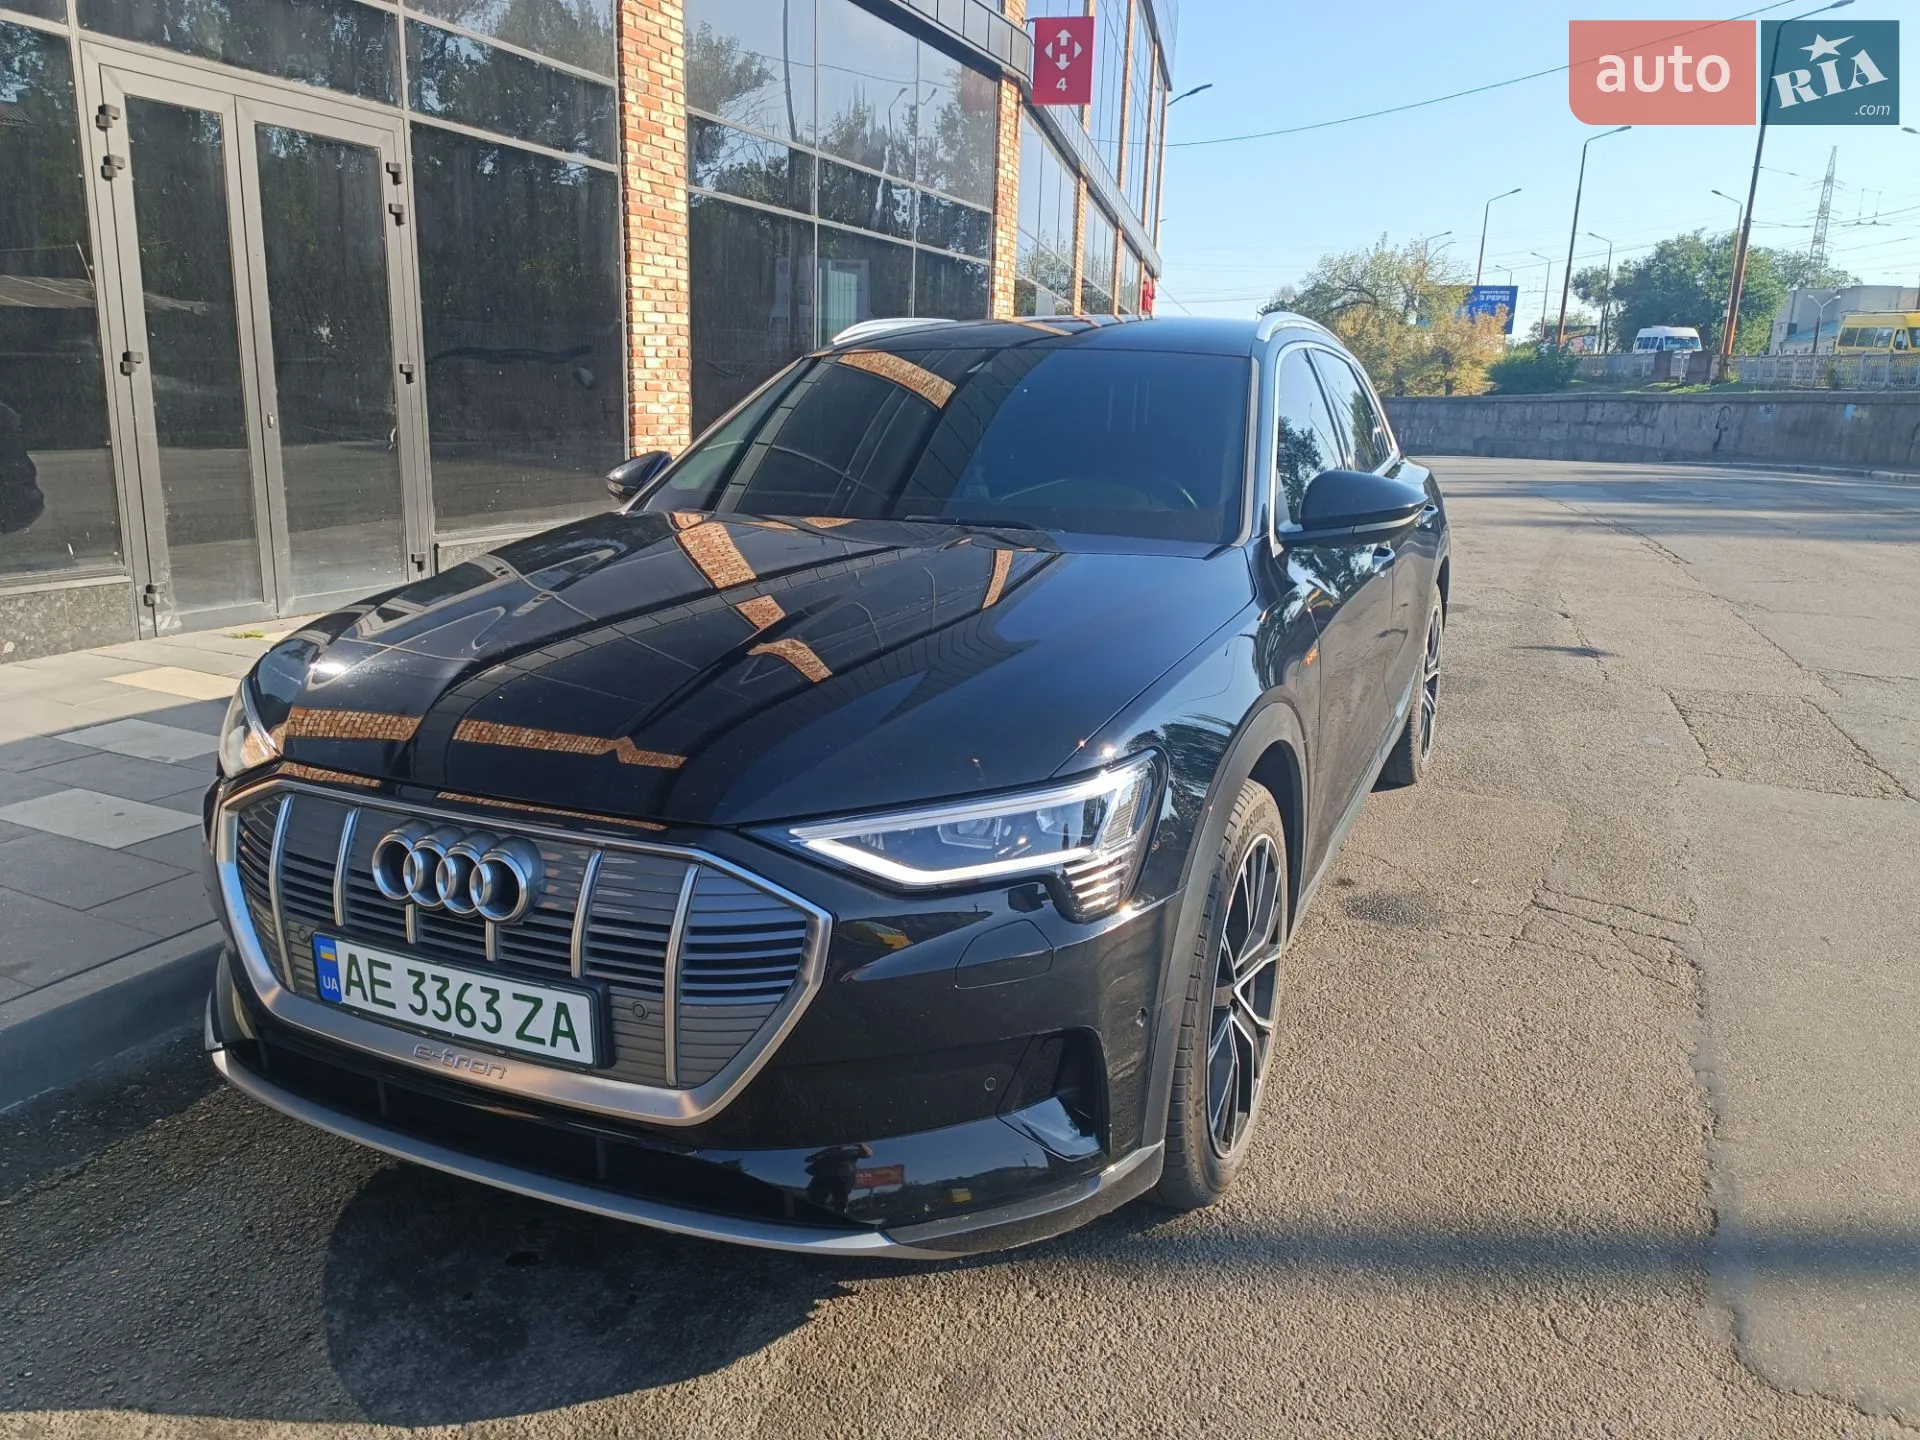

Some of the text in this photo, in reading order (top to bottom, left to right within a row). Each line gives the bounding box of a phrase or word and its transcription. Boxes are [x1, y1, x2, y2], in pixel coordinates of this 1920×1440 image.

[1056, 77, 1067, 91] 4
[322, 975, 339, 993] UA
[345, 953, 580, 1052] AE 3363 ZA
[413, 1043, 507, 1080] e-tron
